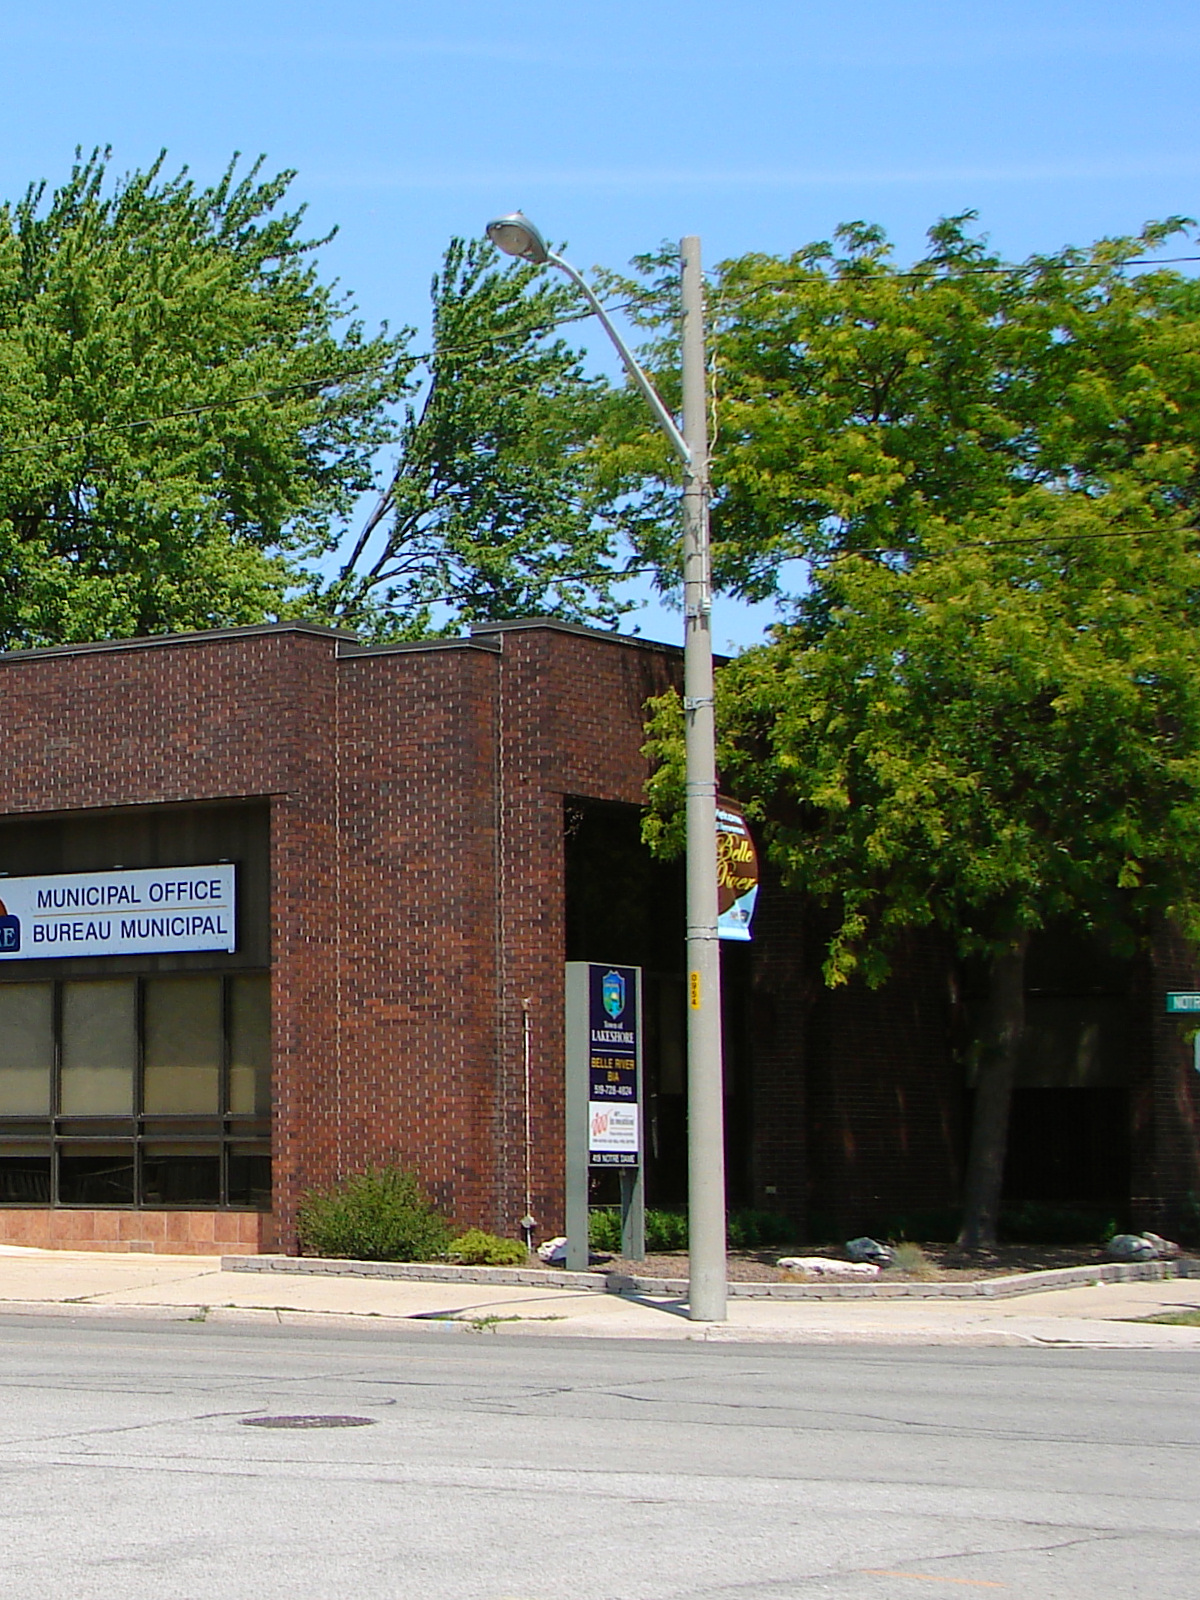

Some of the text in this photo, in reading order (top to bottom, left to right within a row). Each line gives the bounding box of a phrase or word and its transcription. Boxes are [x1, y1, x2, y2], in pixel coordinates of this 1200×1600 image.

[716, 832, 754, 863] Belle
[37, 879, 222, 909] MUNICIPAL OFFICE
[33, 915, 228, 943] BUREAU MUNICIPAL
[591, 1029, 634, 1044] LAKESHORE
[591, 1057, 635, 1070] BELLE RIVER
